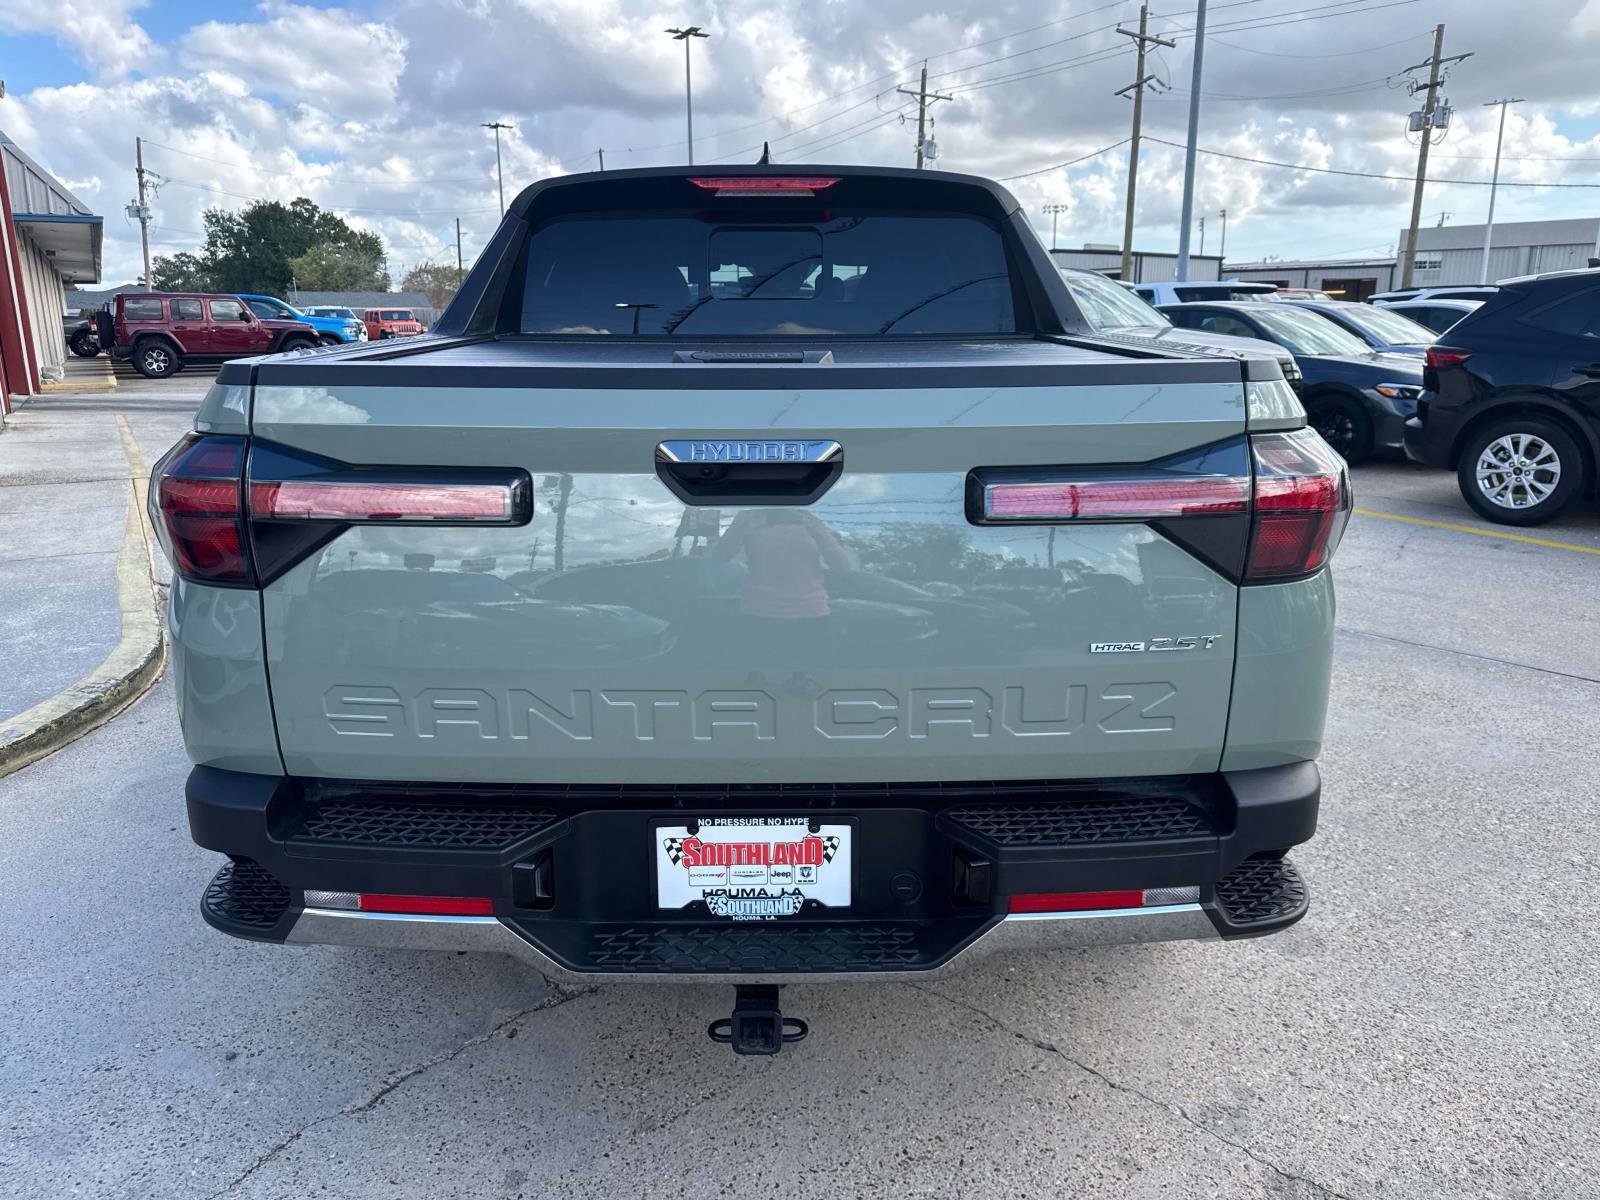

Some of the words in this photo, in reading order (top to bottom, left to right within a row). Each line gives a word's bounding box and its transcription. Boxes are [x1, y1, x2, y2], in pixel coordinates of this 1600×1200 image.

[691, 443, 807, 461] HYUNDAI
[1095, 643, 1141, 651] HTRAC
[323, 684, 776, 740] SANTA
[814, 681, 1177, 739] CRUZ
[698, 818, 712, 826] NO
[715, 818, 765, 826] PRESSURE
[768, 818, 782, 826] NO
[785, 818, 810, 826] HYPE
[683, 837, 823, 867] SOUTHLAND
[771, 870, 791, 878] Jeep
[717, 897, 794, 915] SOUTHLAND
